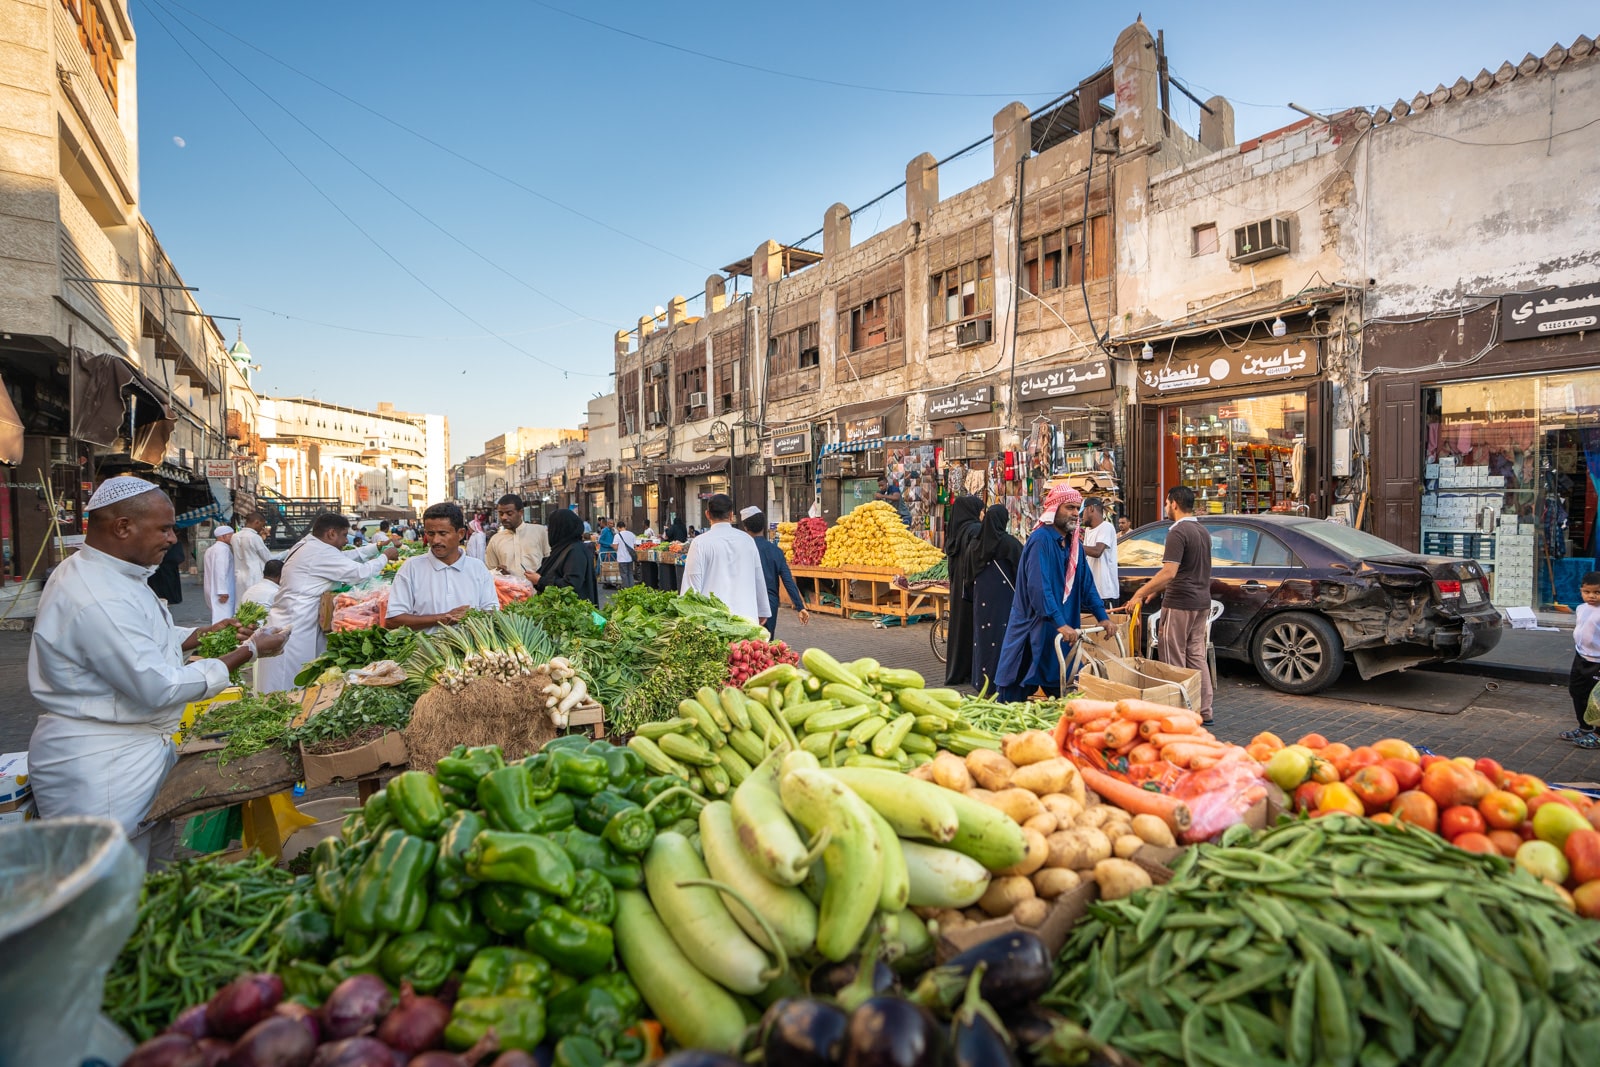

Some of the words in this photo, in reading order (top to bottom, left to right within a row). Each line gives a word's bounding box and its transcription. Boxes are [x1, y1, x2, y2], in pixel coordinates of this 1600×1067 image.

[1066, 362, 1107, 383] قمة
[1241, 348, 1307, 375] ياسين
[1021, 372, 1064, 395] الابداع
[1143, 363, 1200, 387] للعطارة
[930, 395, 958, 413] الخليل
